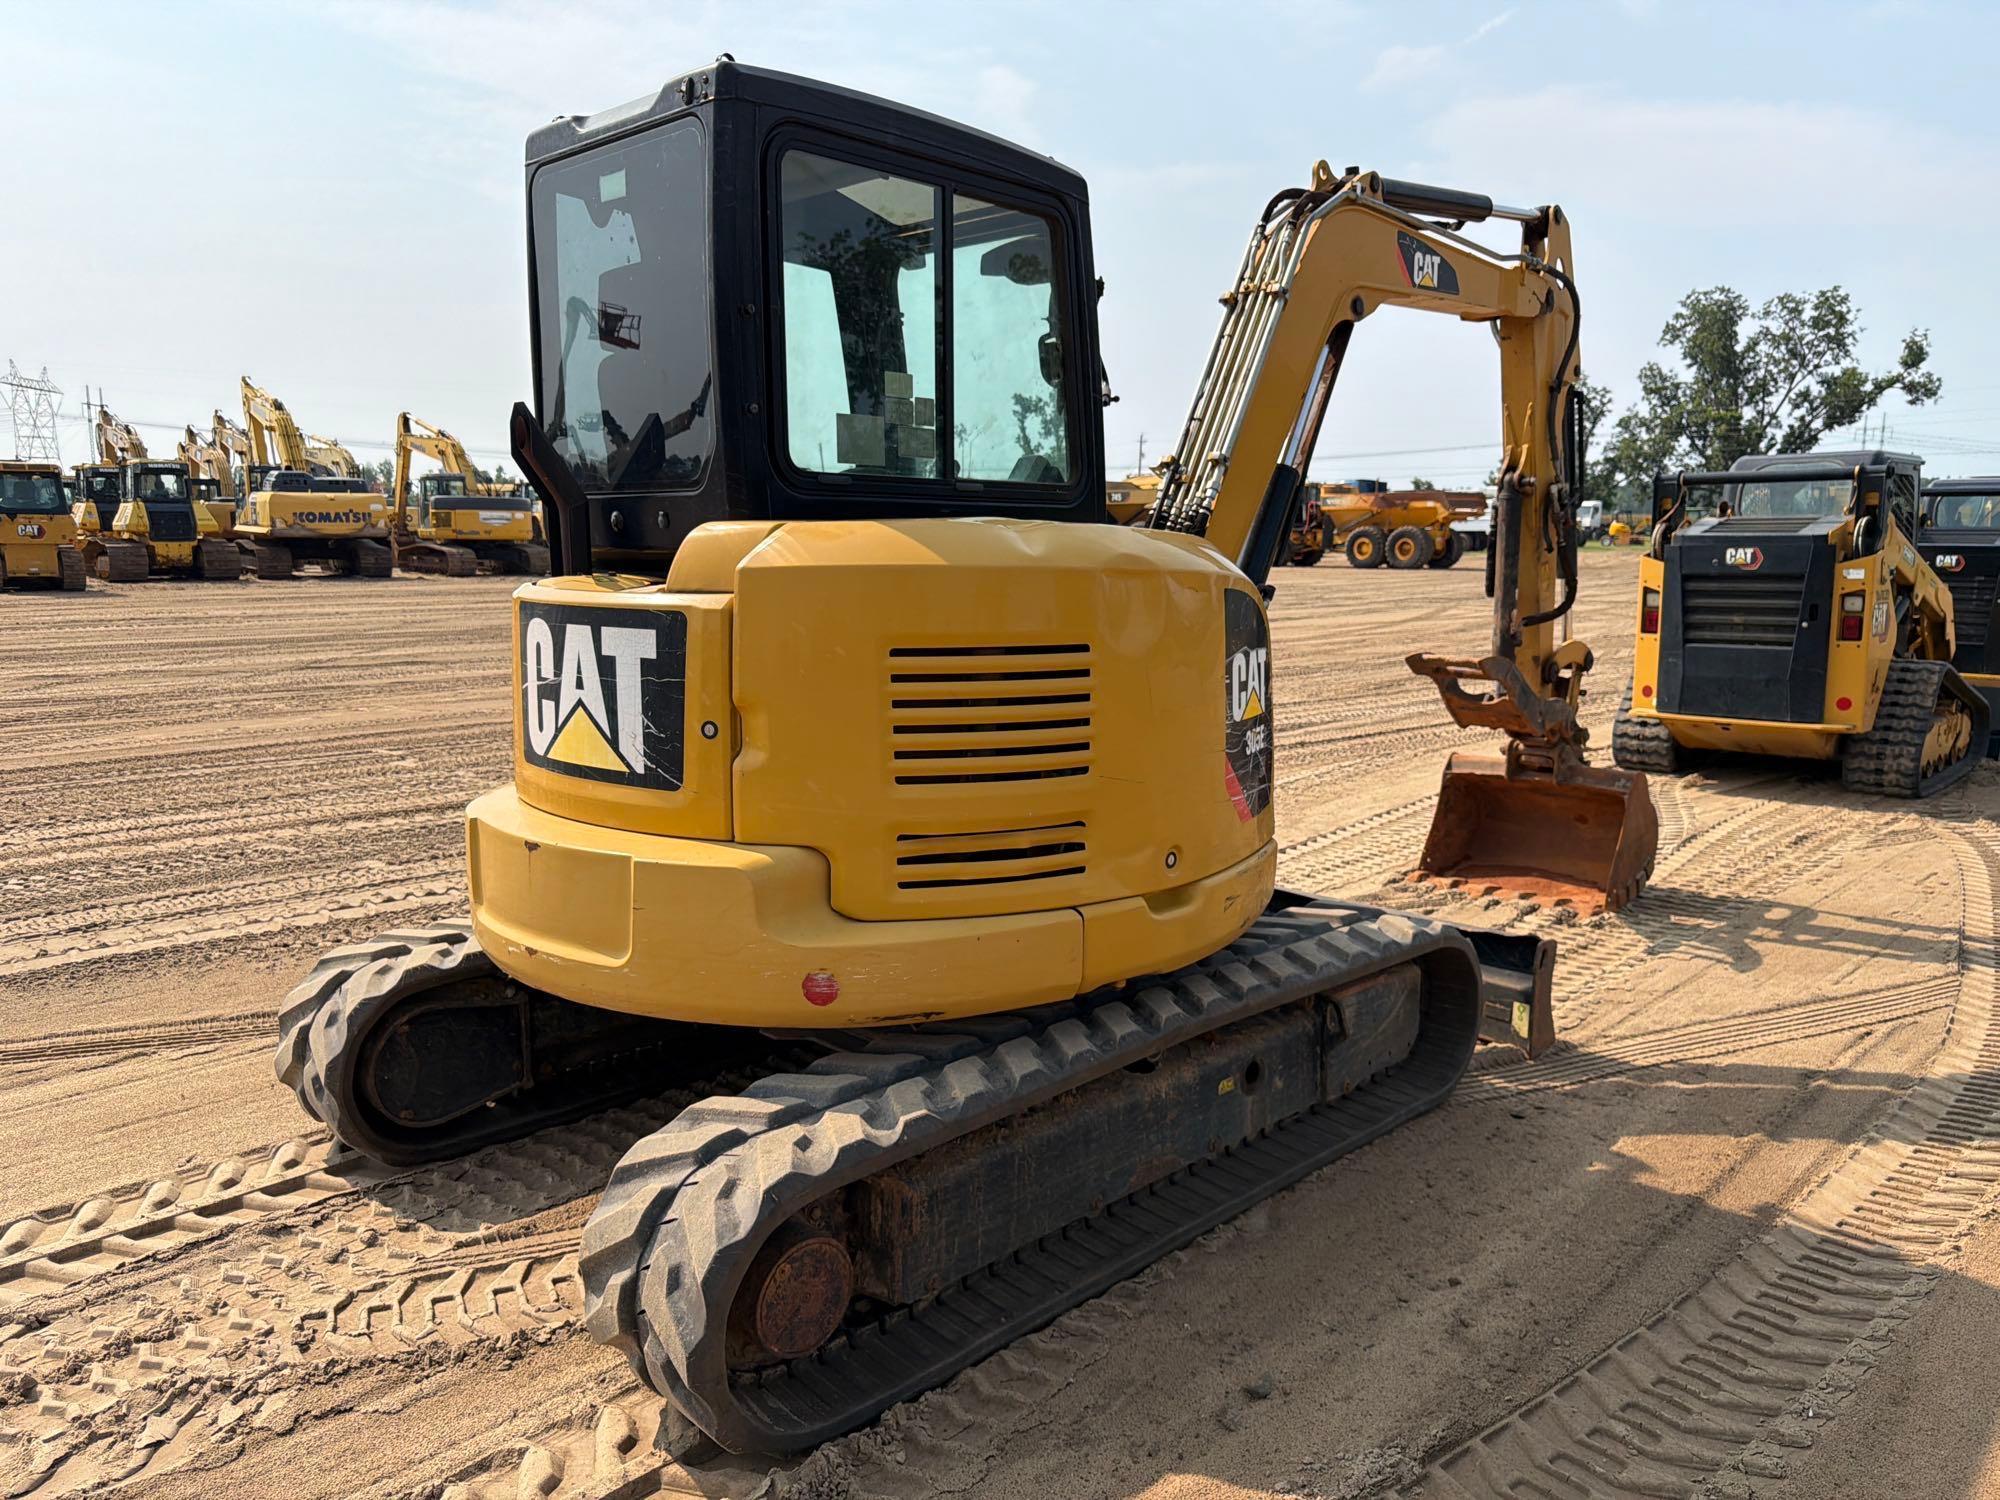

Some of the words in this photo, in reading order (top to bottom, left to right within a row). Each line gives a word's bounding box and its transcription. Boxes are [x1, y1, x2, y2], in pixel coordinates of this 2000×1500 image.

[1413, 251, 1441, 288] CAT
[293, 509, 372, 523] KOMATSU
[17, 524, 39, 536] CAT
[1725, 547, 1754, 565] CAT
[1935, 554, 1959, 567] CAT
[1232, 647, 1267, 722] CAT
[526, 617, 657, 775] CAT
